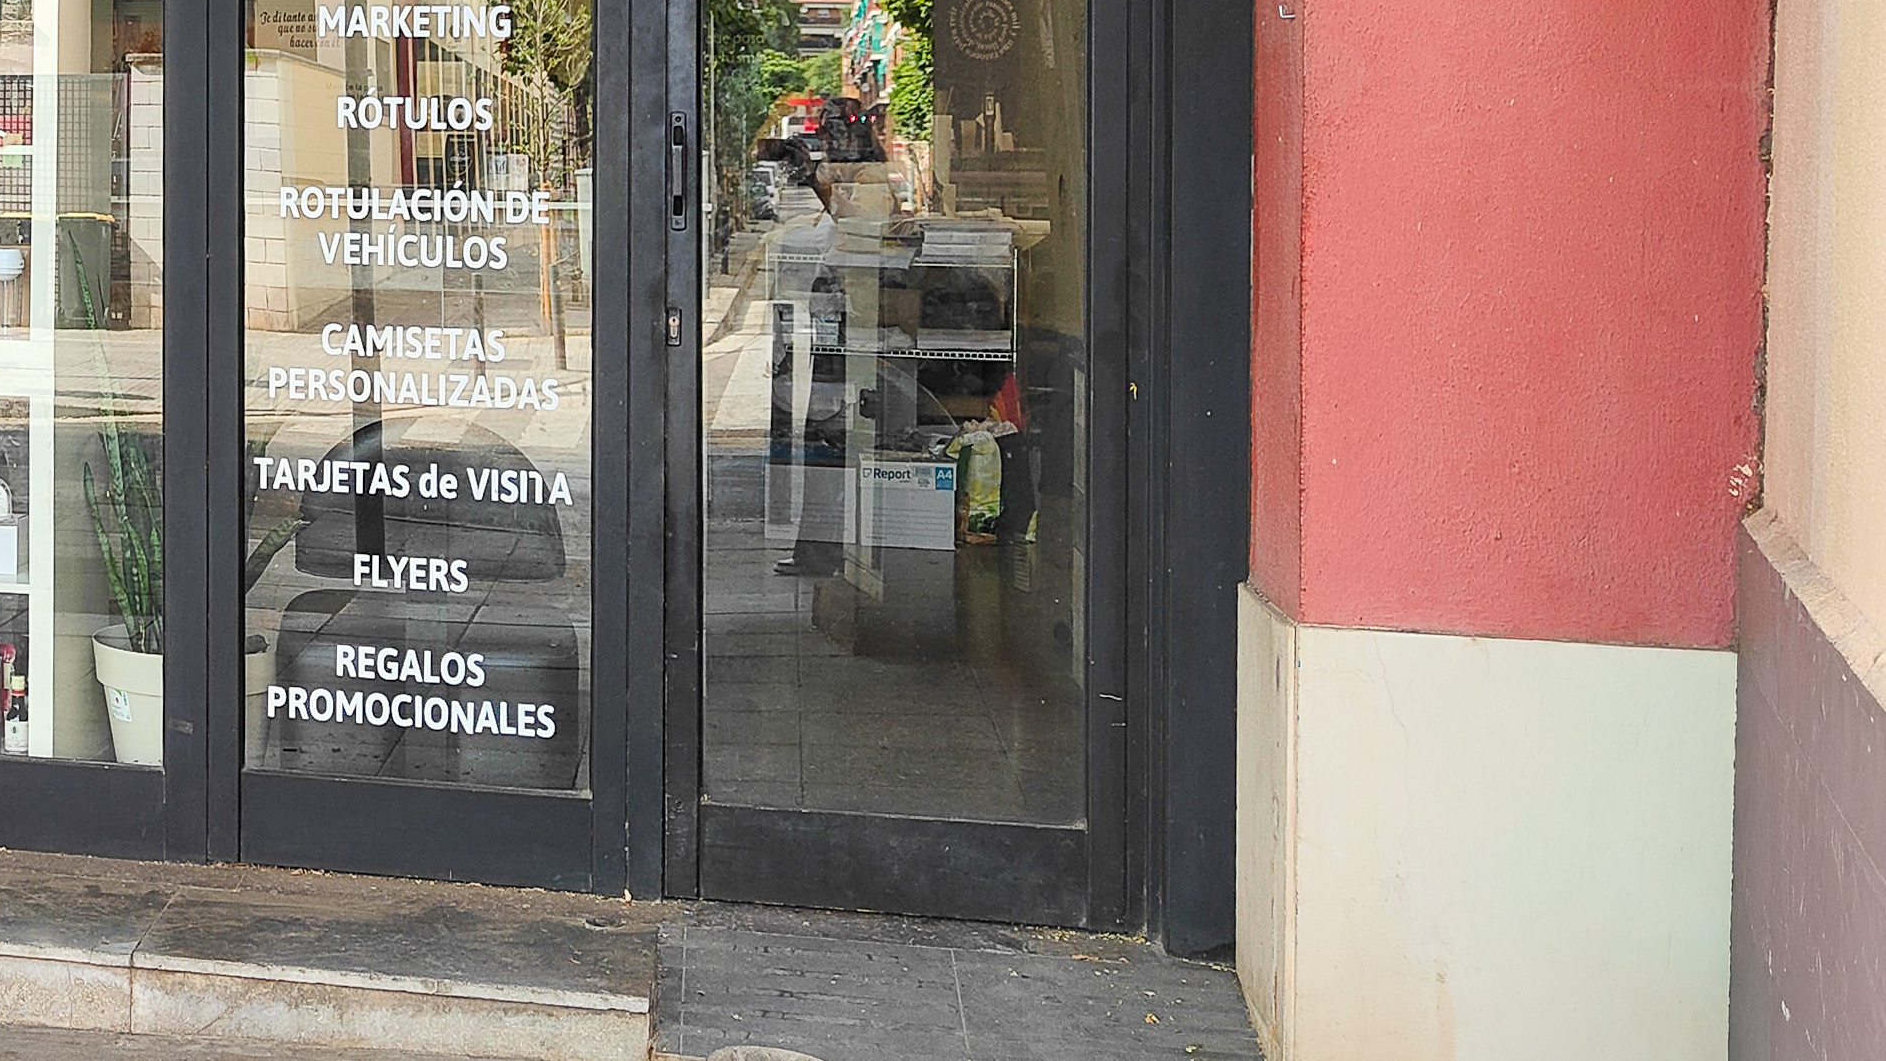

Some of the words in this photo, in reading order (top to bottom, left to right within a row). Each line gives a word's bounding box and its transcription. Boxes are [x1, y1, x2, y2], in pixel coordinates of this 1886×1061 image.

[318, 5, 512, 38] MARKETING
[337, 87, 493, 130] RÓTULOS
[280, 181, 494, 223] ROTULACIÓN
[506, 192, 550, 224] DE
[318, 224, 508, 270] VEHÍCULOS
[321, 323, 505, 363] CAMISETAS
[268, 367, 560, 411] PERSONALIZADAS
[253, 457, 410, 499] TARJETAS
[419, 464, 458, 499] de
[466, 468, 573, 506] VISITA
[874, 468, 911, 481] Report
[936, 469, 953, 480] A4
[353, 553, 469, 593] FLYERS
[335, 643, 486, 688] REGALOS
[266, 685, 556, 739] PROMOCIONALES
